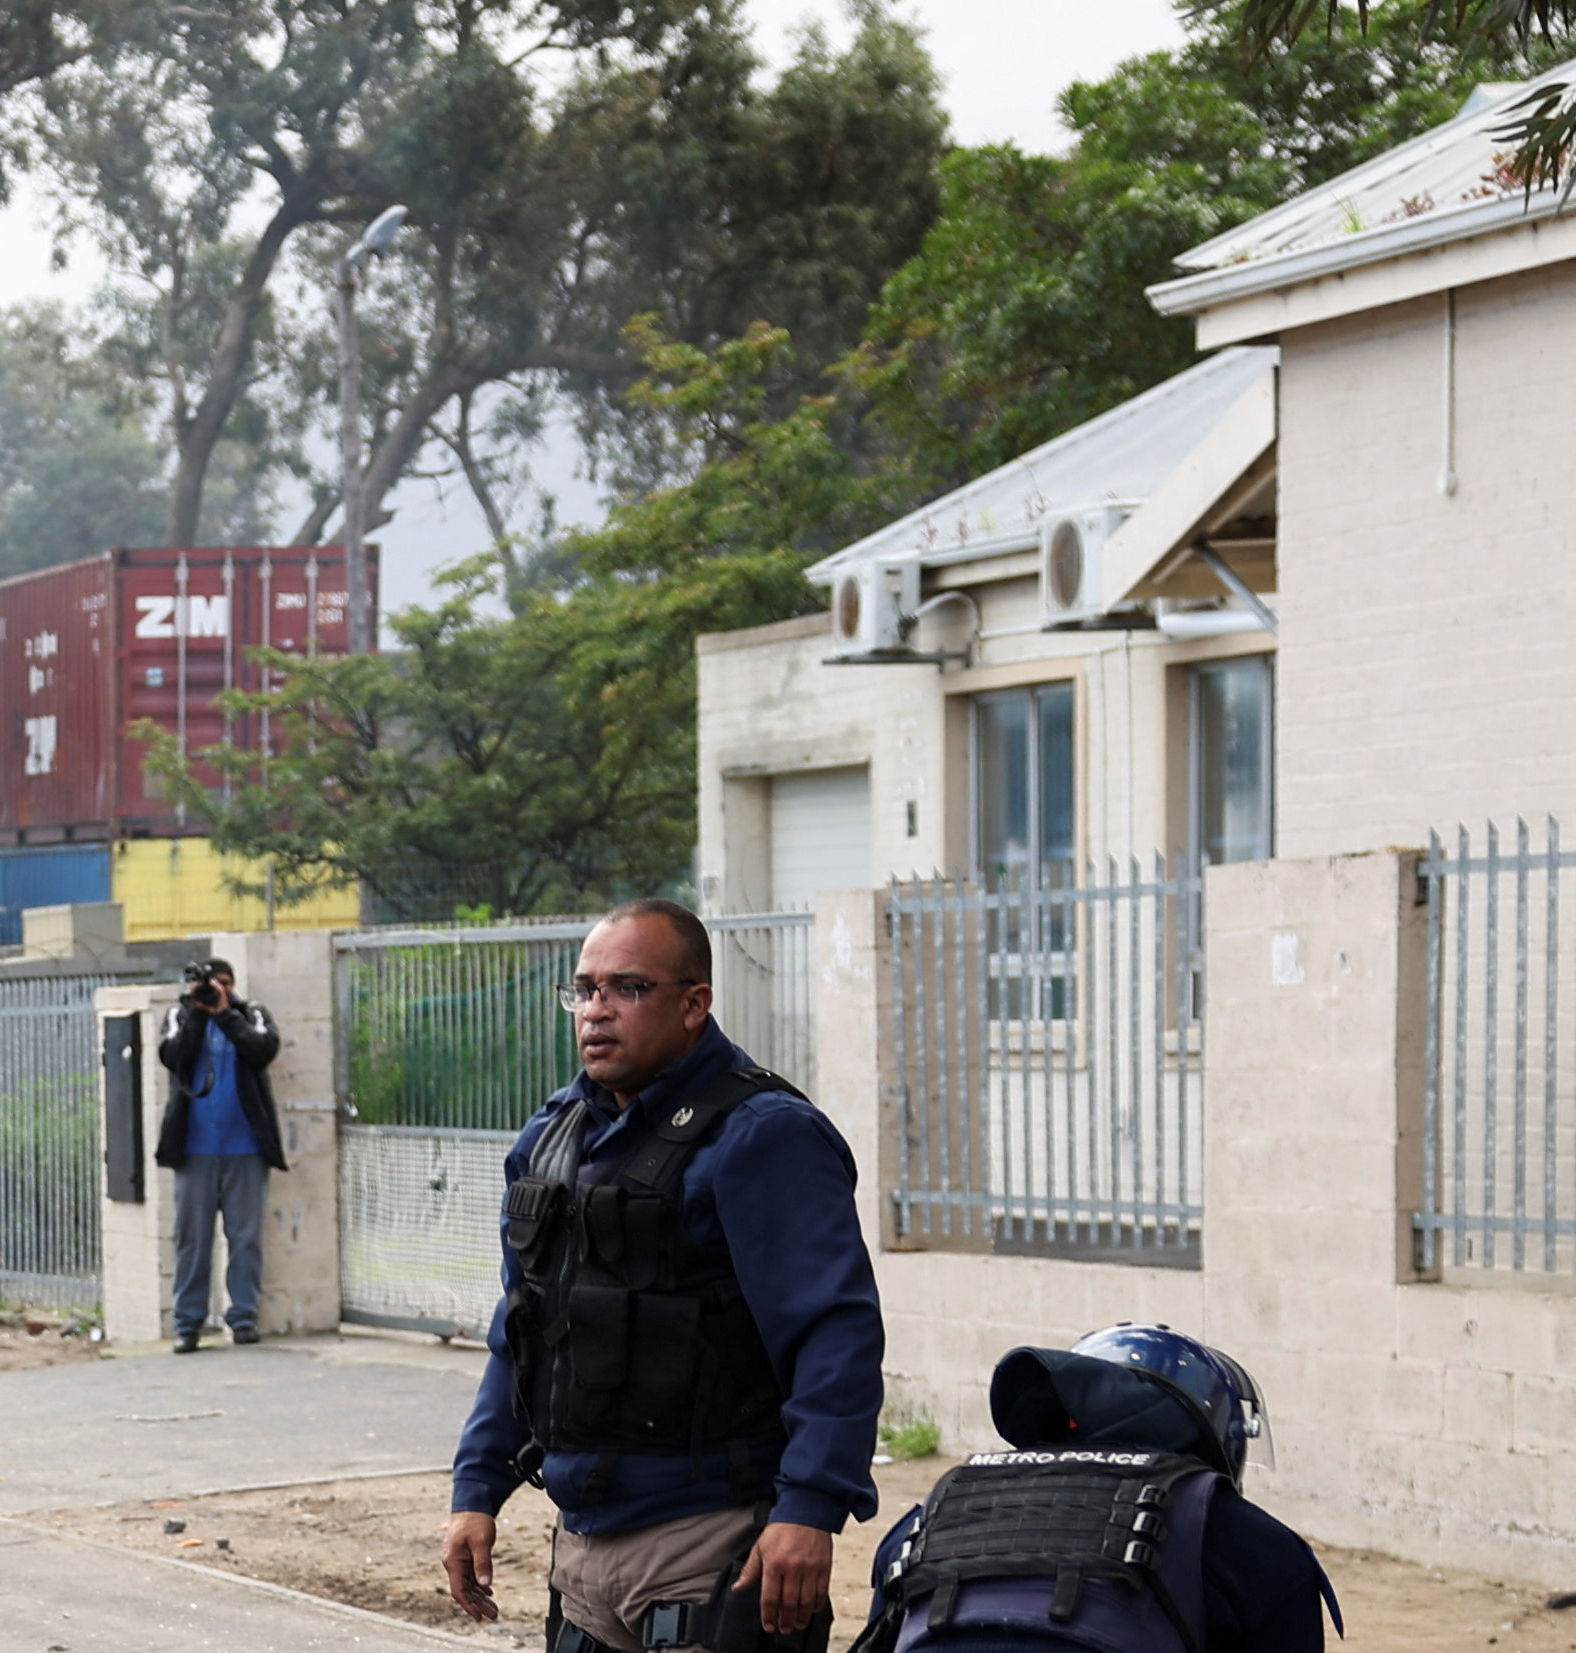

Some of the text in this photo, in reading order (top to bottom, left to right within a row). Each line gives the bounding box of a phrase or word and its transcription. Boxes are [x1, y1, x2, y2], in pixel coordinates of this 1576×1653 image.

[135, 595, 231, 638] ZIM
[969, 1451, 1151, 1466] METRO POLICE
